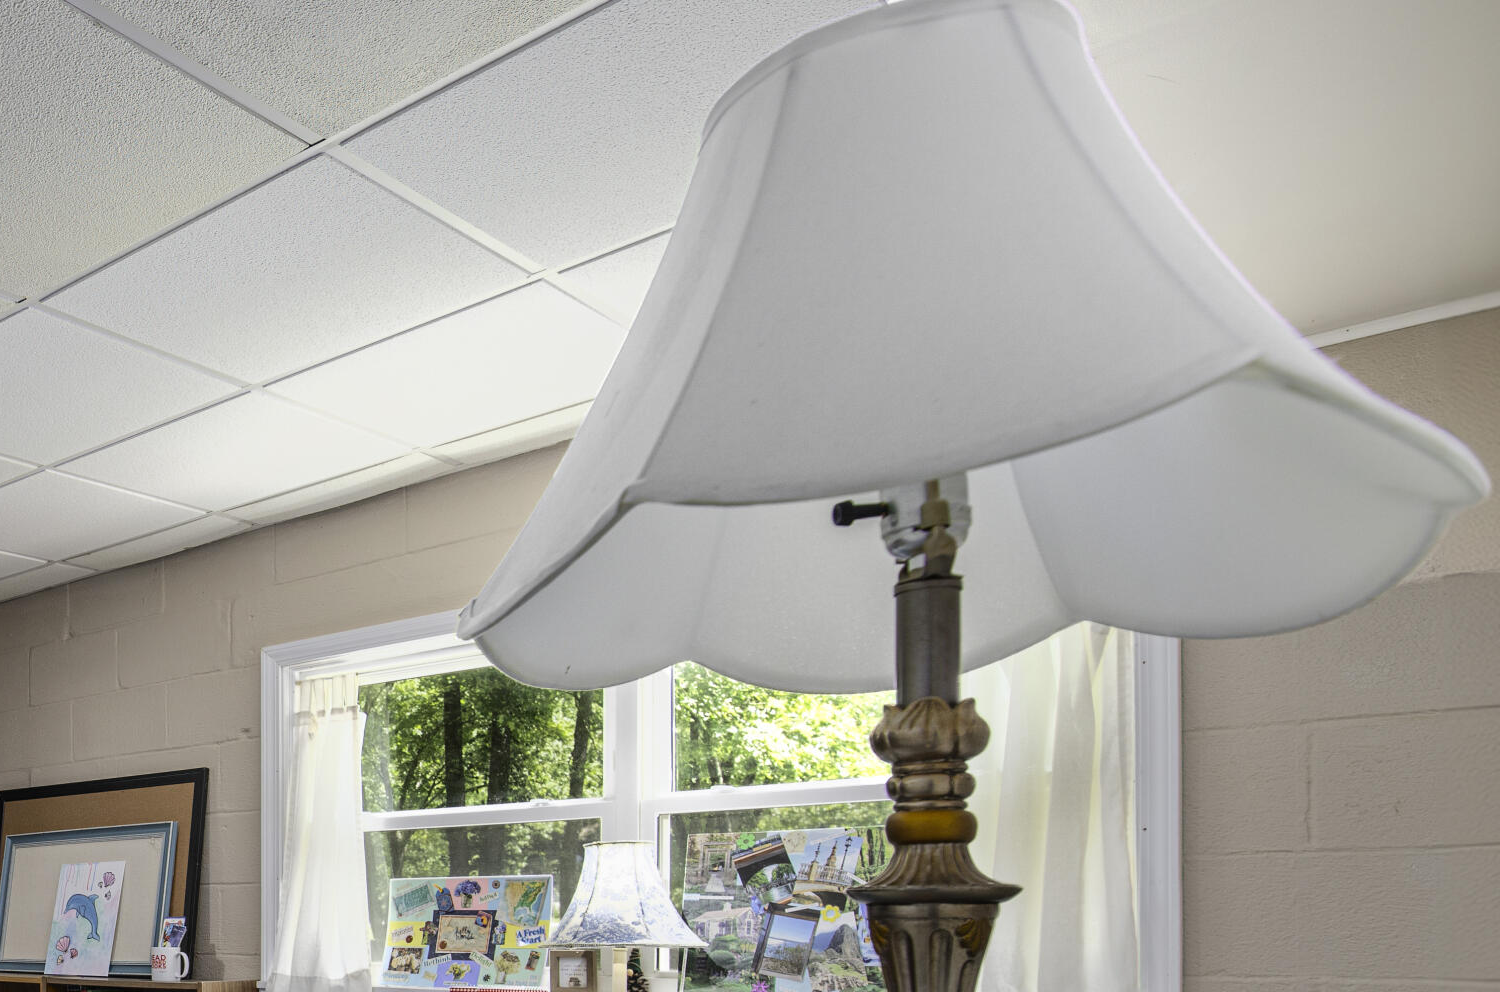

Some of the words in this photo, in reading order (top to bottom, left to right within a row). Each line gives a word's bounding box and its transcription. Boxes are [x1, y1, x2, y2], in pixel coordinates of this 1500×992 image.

[523, 926, 545, 937] Fresh
[521, 936, 541, 944] Start
[423, 956, 451, 967] Rethink
